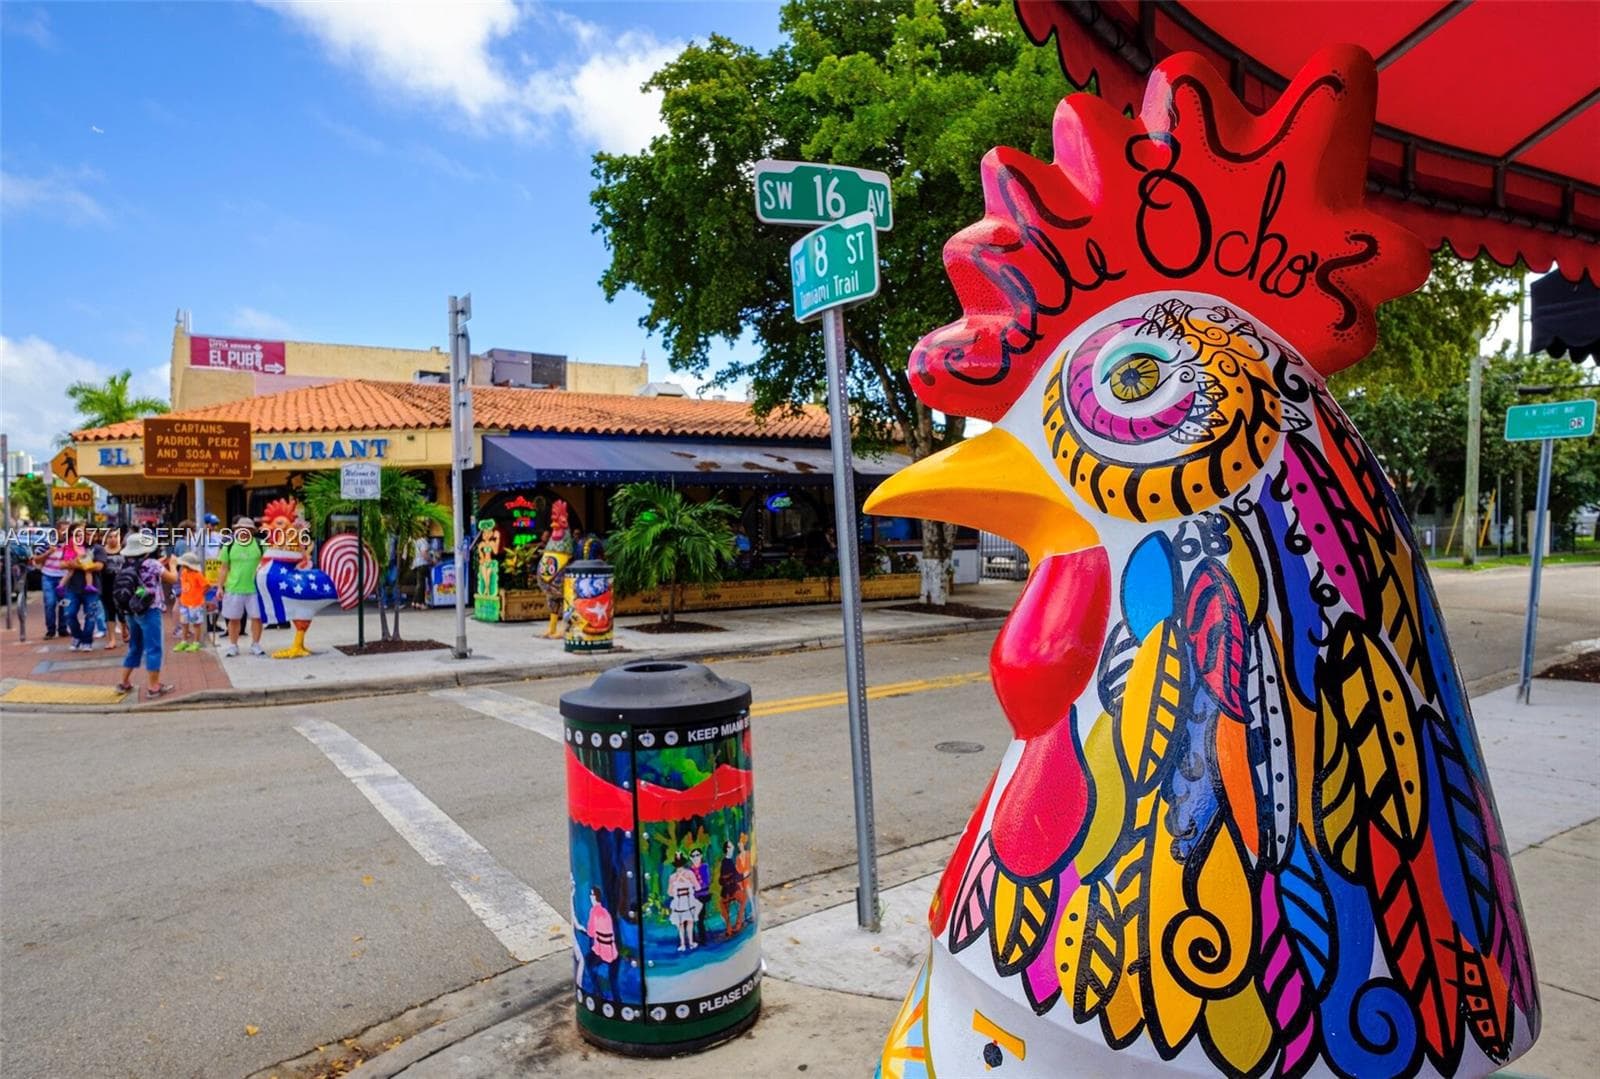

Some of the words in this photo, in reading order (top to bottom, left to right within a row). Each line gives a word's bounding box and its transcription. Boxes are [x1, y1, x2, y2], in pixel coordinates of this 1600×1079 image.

[762, 179, 793, 210] SW
[813, 174, 846, 219] 16
[866, 189, 885, 217] AV
[814, 234, 828, 278] 8
[846, 230, 865, 265] ST
[833, 270, 859, 297] Trail
[209, 350, 225, 365] EL
[228, 351, 254, 366] PUB
[98, 447, 130, 466] EL
[255, 438, 388, 461] TAURANT
[207, 437, 240, 448] PEREZ
[156, 448, 178, 459] AND
[185, 449, 212, 460] SOSA
[219, 450, 240, 460] WAY
[54, 491, 91, 502] AHEAD
[687, 726, 719, 743] KEEP
[699, 989, 741, 1014] PLEASE
[743, 980, 753, 996] DO
